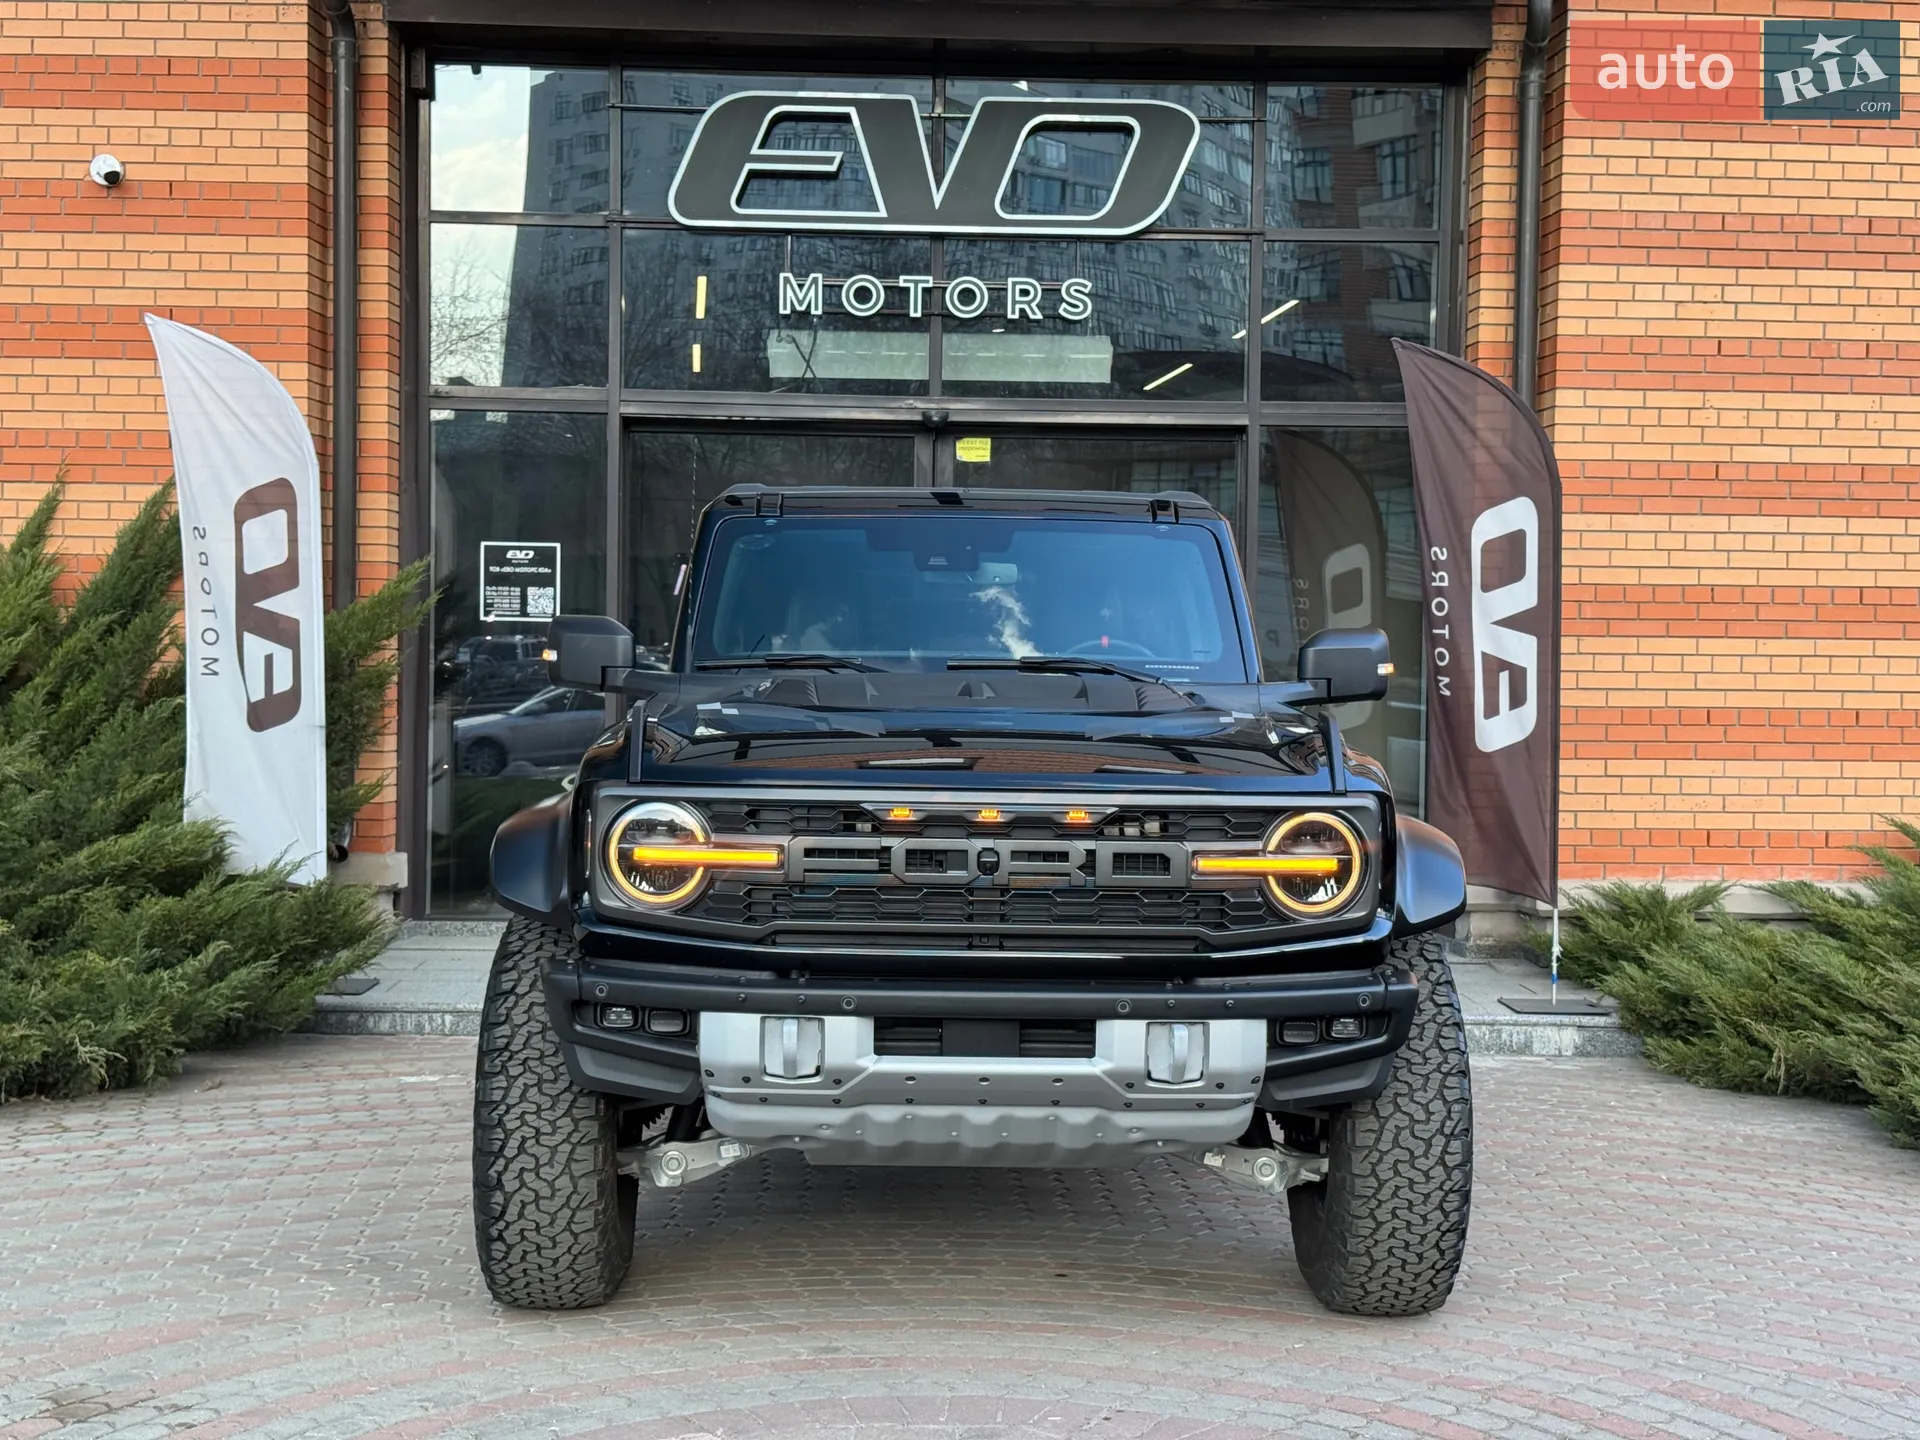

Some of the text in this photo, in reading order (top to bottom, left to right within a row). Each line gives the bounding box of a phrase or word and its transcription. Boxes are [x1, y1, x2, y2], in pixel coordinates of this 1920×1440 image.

[668, 91, 1200, 236] EVO
[778, 272, 1093, 321] MOTORS
[786, 835, 1194, 888] FORD
